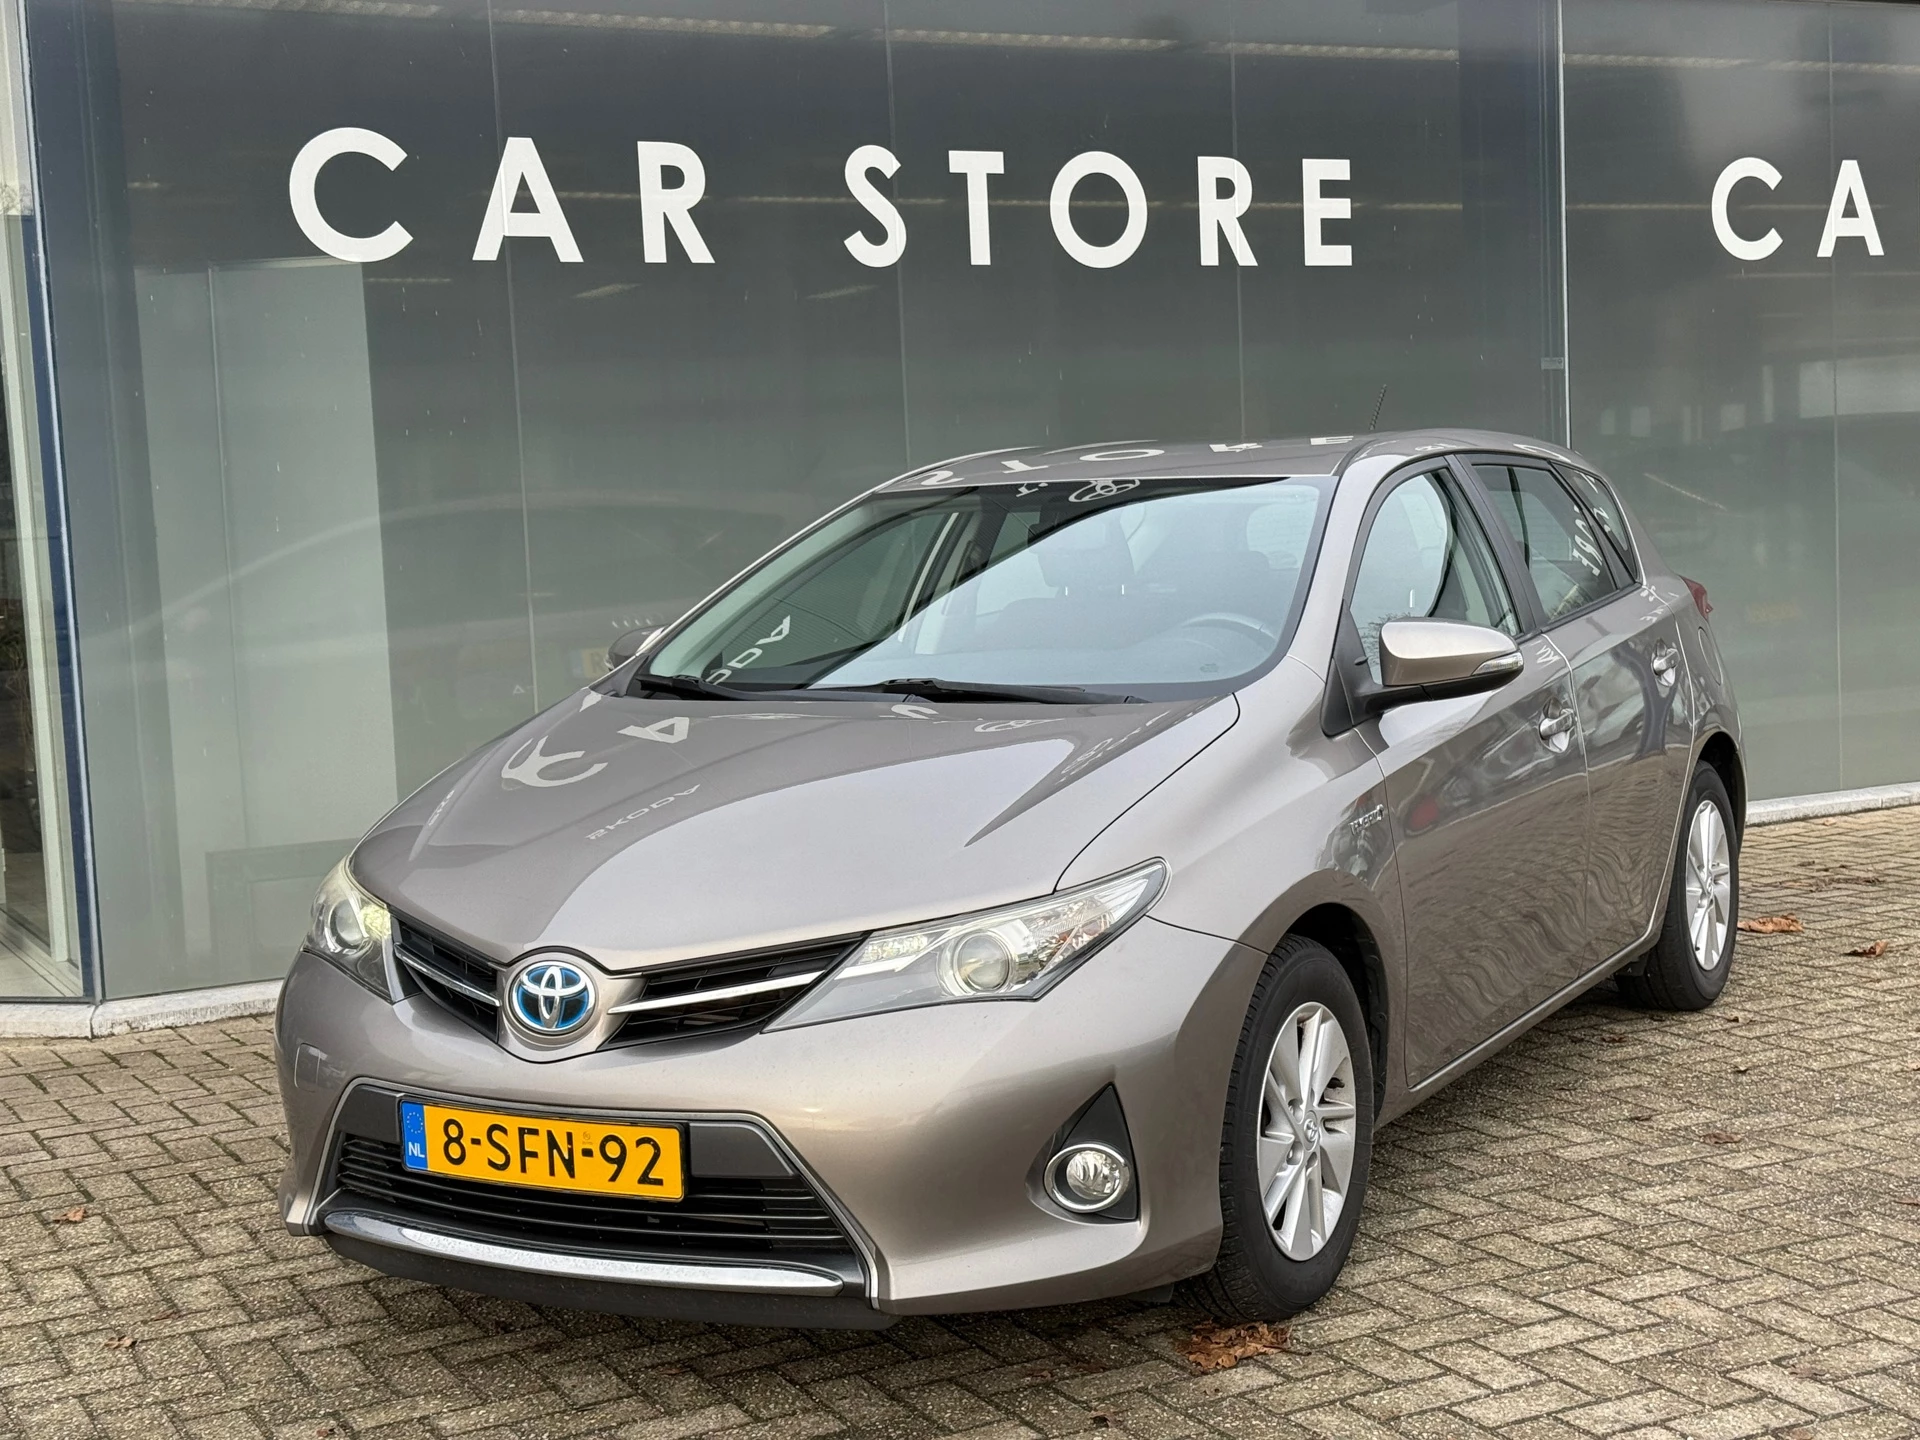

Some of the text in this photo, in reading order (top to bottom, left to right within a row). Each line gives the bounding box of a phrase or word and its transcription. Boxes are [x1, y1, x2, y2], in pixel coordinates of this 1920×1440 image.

[289, 127, 1353, 269] CAR STORE
[1711, 156, 1885, 261] CA
[408, 1141, 426, 1159] NL
[443, 1118, 664, 1187] 8-SFN-92
